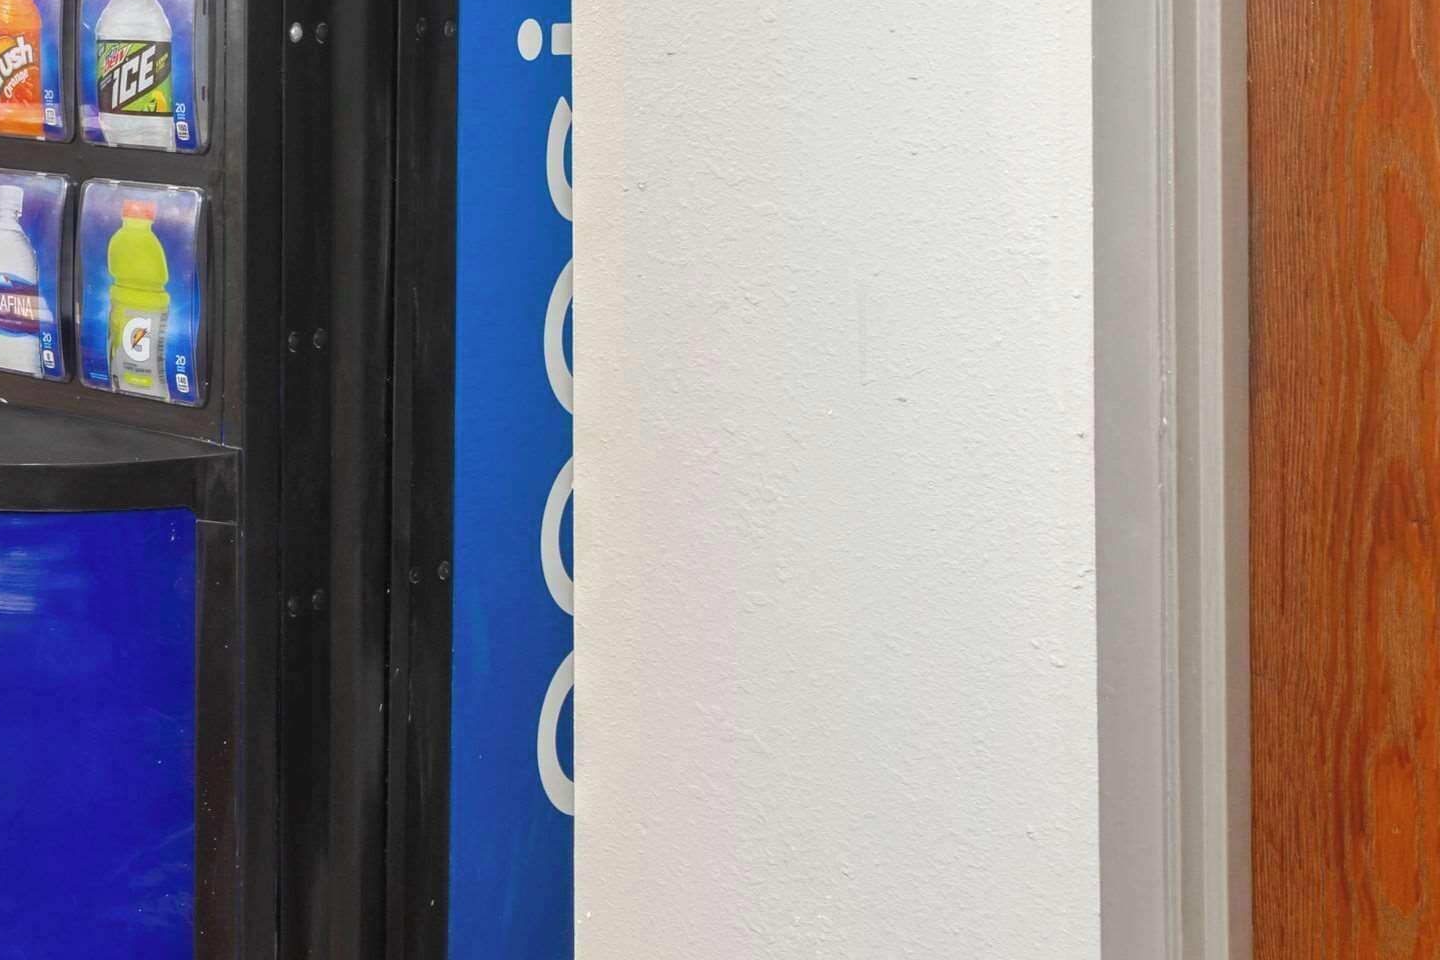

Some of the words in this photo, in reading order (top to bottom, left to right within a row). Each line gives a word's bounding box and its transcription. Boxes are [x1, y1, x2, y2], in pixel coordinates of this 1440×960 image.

[111, 44, 157, 110] ICE
[175, 102, 186, 113] 20
[42, 331, 52, 343] 20
[122, 317, 152, 362] G
[175, 354, 186, 366] 20
